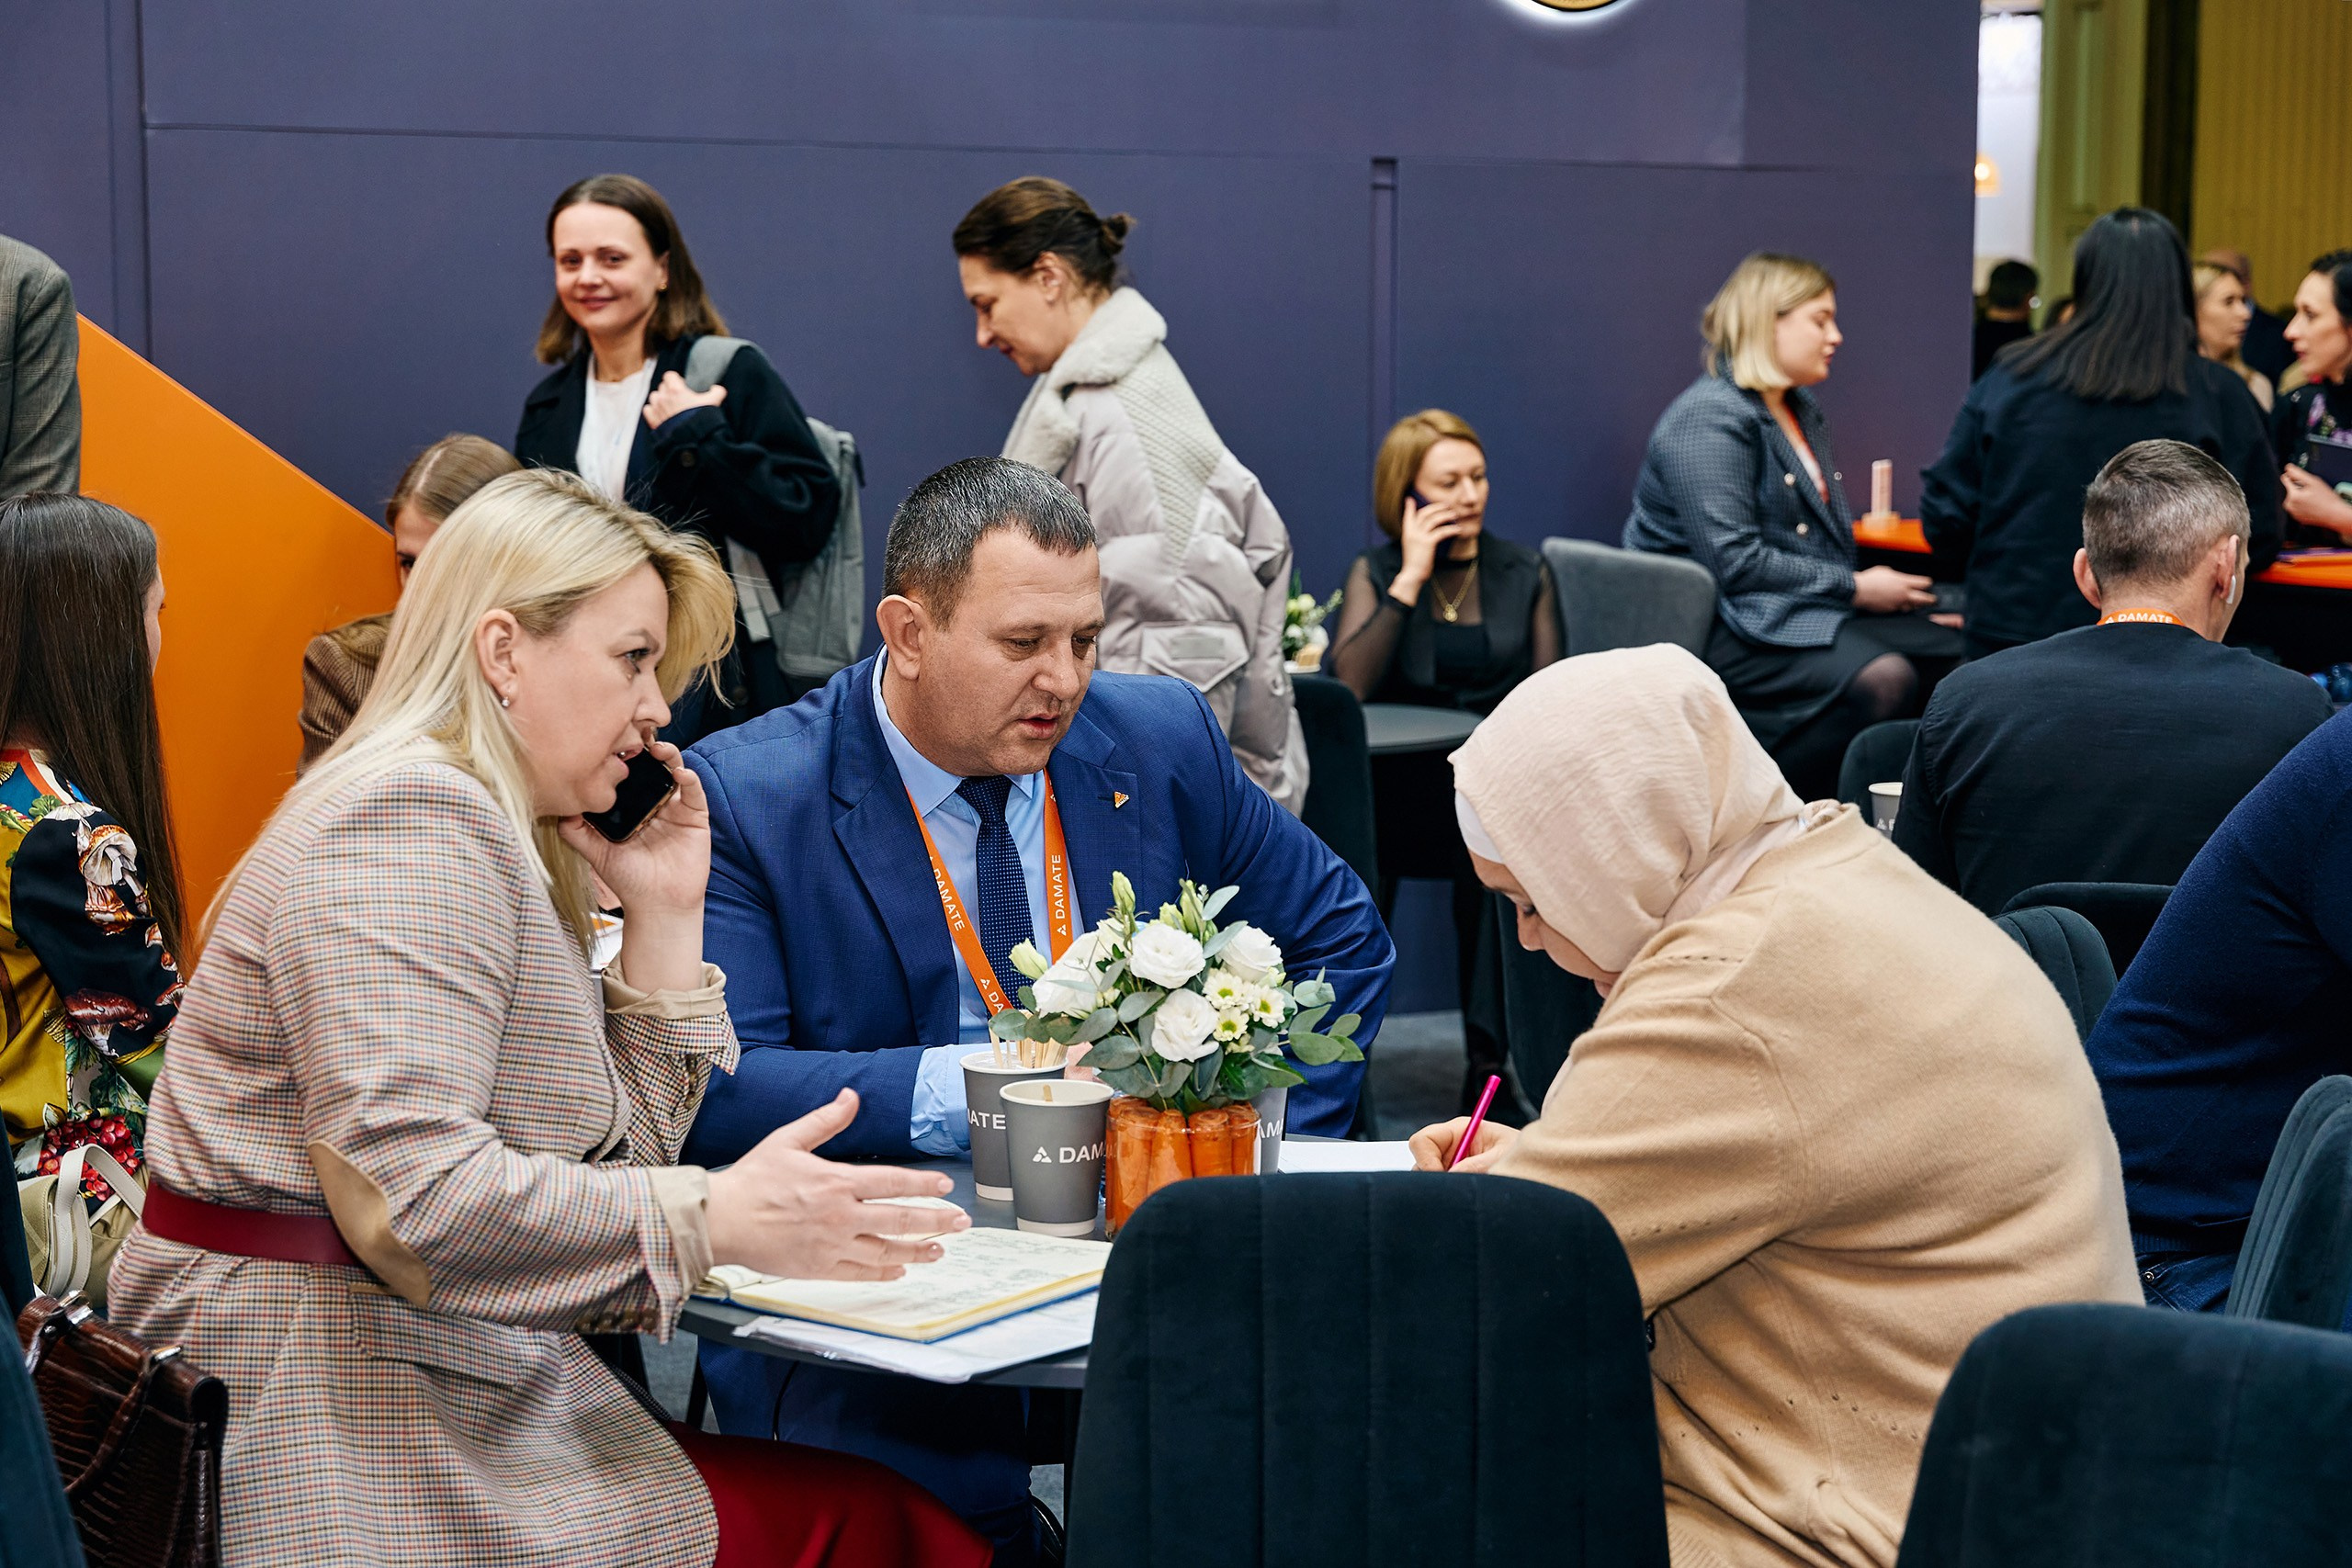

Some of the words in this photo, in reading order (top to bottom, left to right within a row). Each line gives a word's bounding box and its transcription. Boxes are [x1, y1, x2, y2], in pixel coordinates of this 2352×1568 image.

[2118, 613, 2173, 624] DAMATE
[1051, 854, 1066, 919] DAMATE
[933, 868, 966, 931] DAMATE
[967, 1108, 1006, 1130] ATE
[1059, 1141, 1105, 1163] DAM
